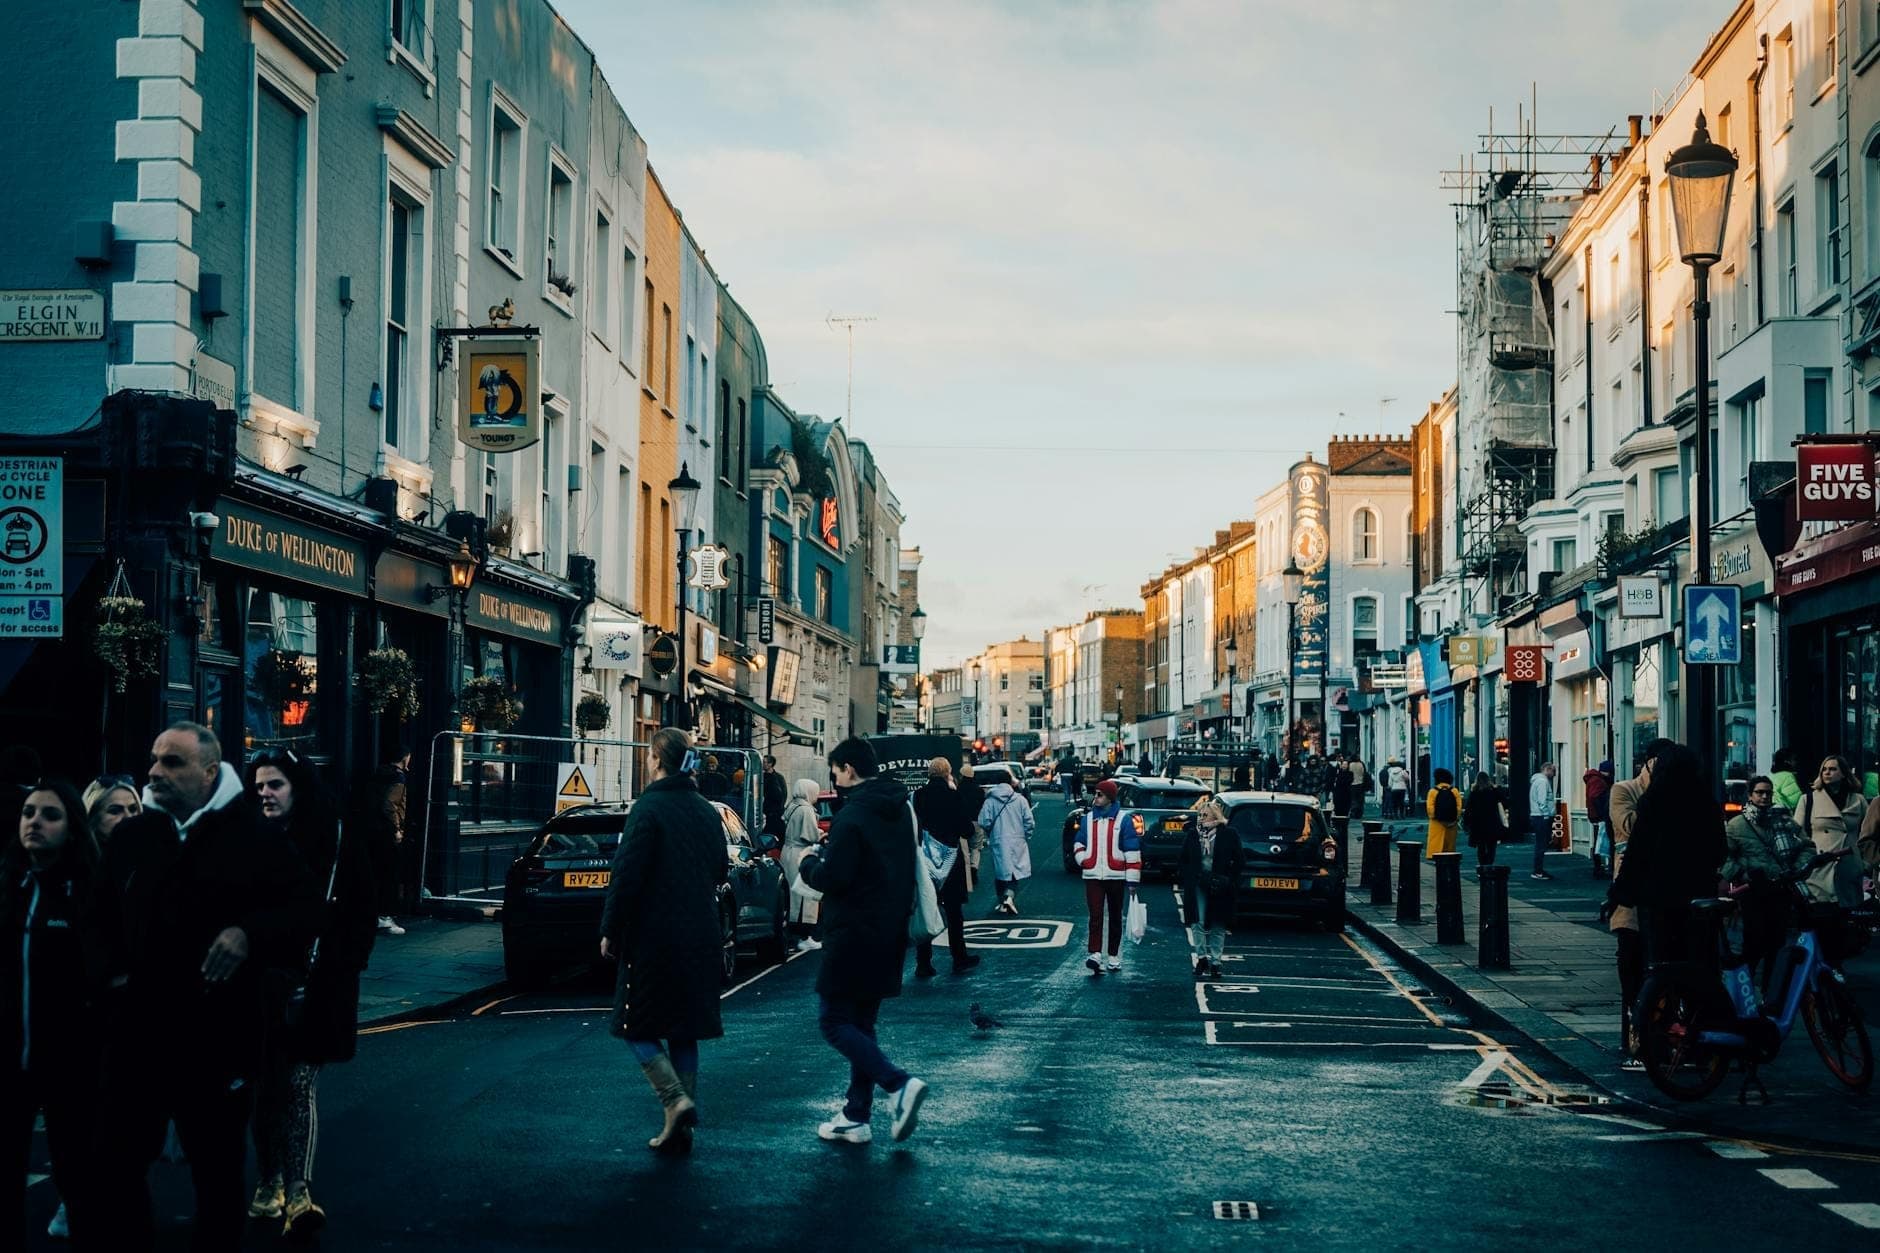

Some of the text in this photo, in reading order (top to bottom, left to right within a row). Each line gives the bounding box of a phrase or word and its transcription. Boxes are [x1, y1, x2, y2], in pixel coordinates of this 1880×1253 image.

[18, 305, 77, 320] ELGIN
[198, 375, 234, 401] PORTOBELLO
[11, 472, 51, 482] CYCLE
[1810, 463, 1865, 482] FIVE
[1803, 481, 1873, 501] GUYS
[227, 515, 263, 551] DUKE
[280, 532, 355, 577] WELLINGTON
[0, 568, 16, 577] on
[25, 567, 44, 577] Sat
[35, 583, 52, 593] pm
[480, 593, 500, 620] DUKE
[509, 602, 551, 633] WELLINGTON
[0, 623, 59, 633] for access
[762, 603, 770, 641] HONEST
[569, 874, 599, 884] RV72
[963, 927, 1051, 940] 20
